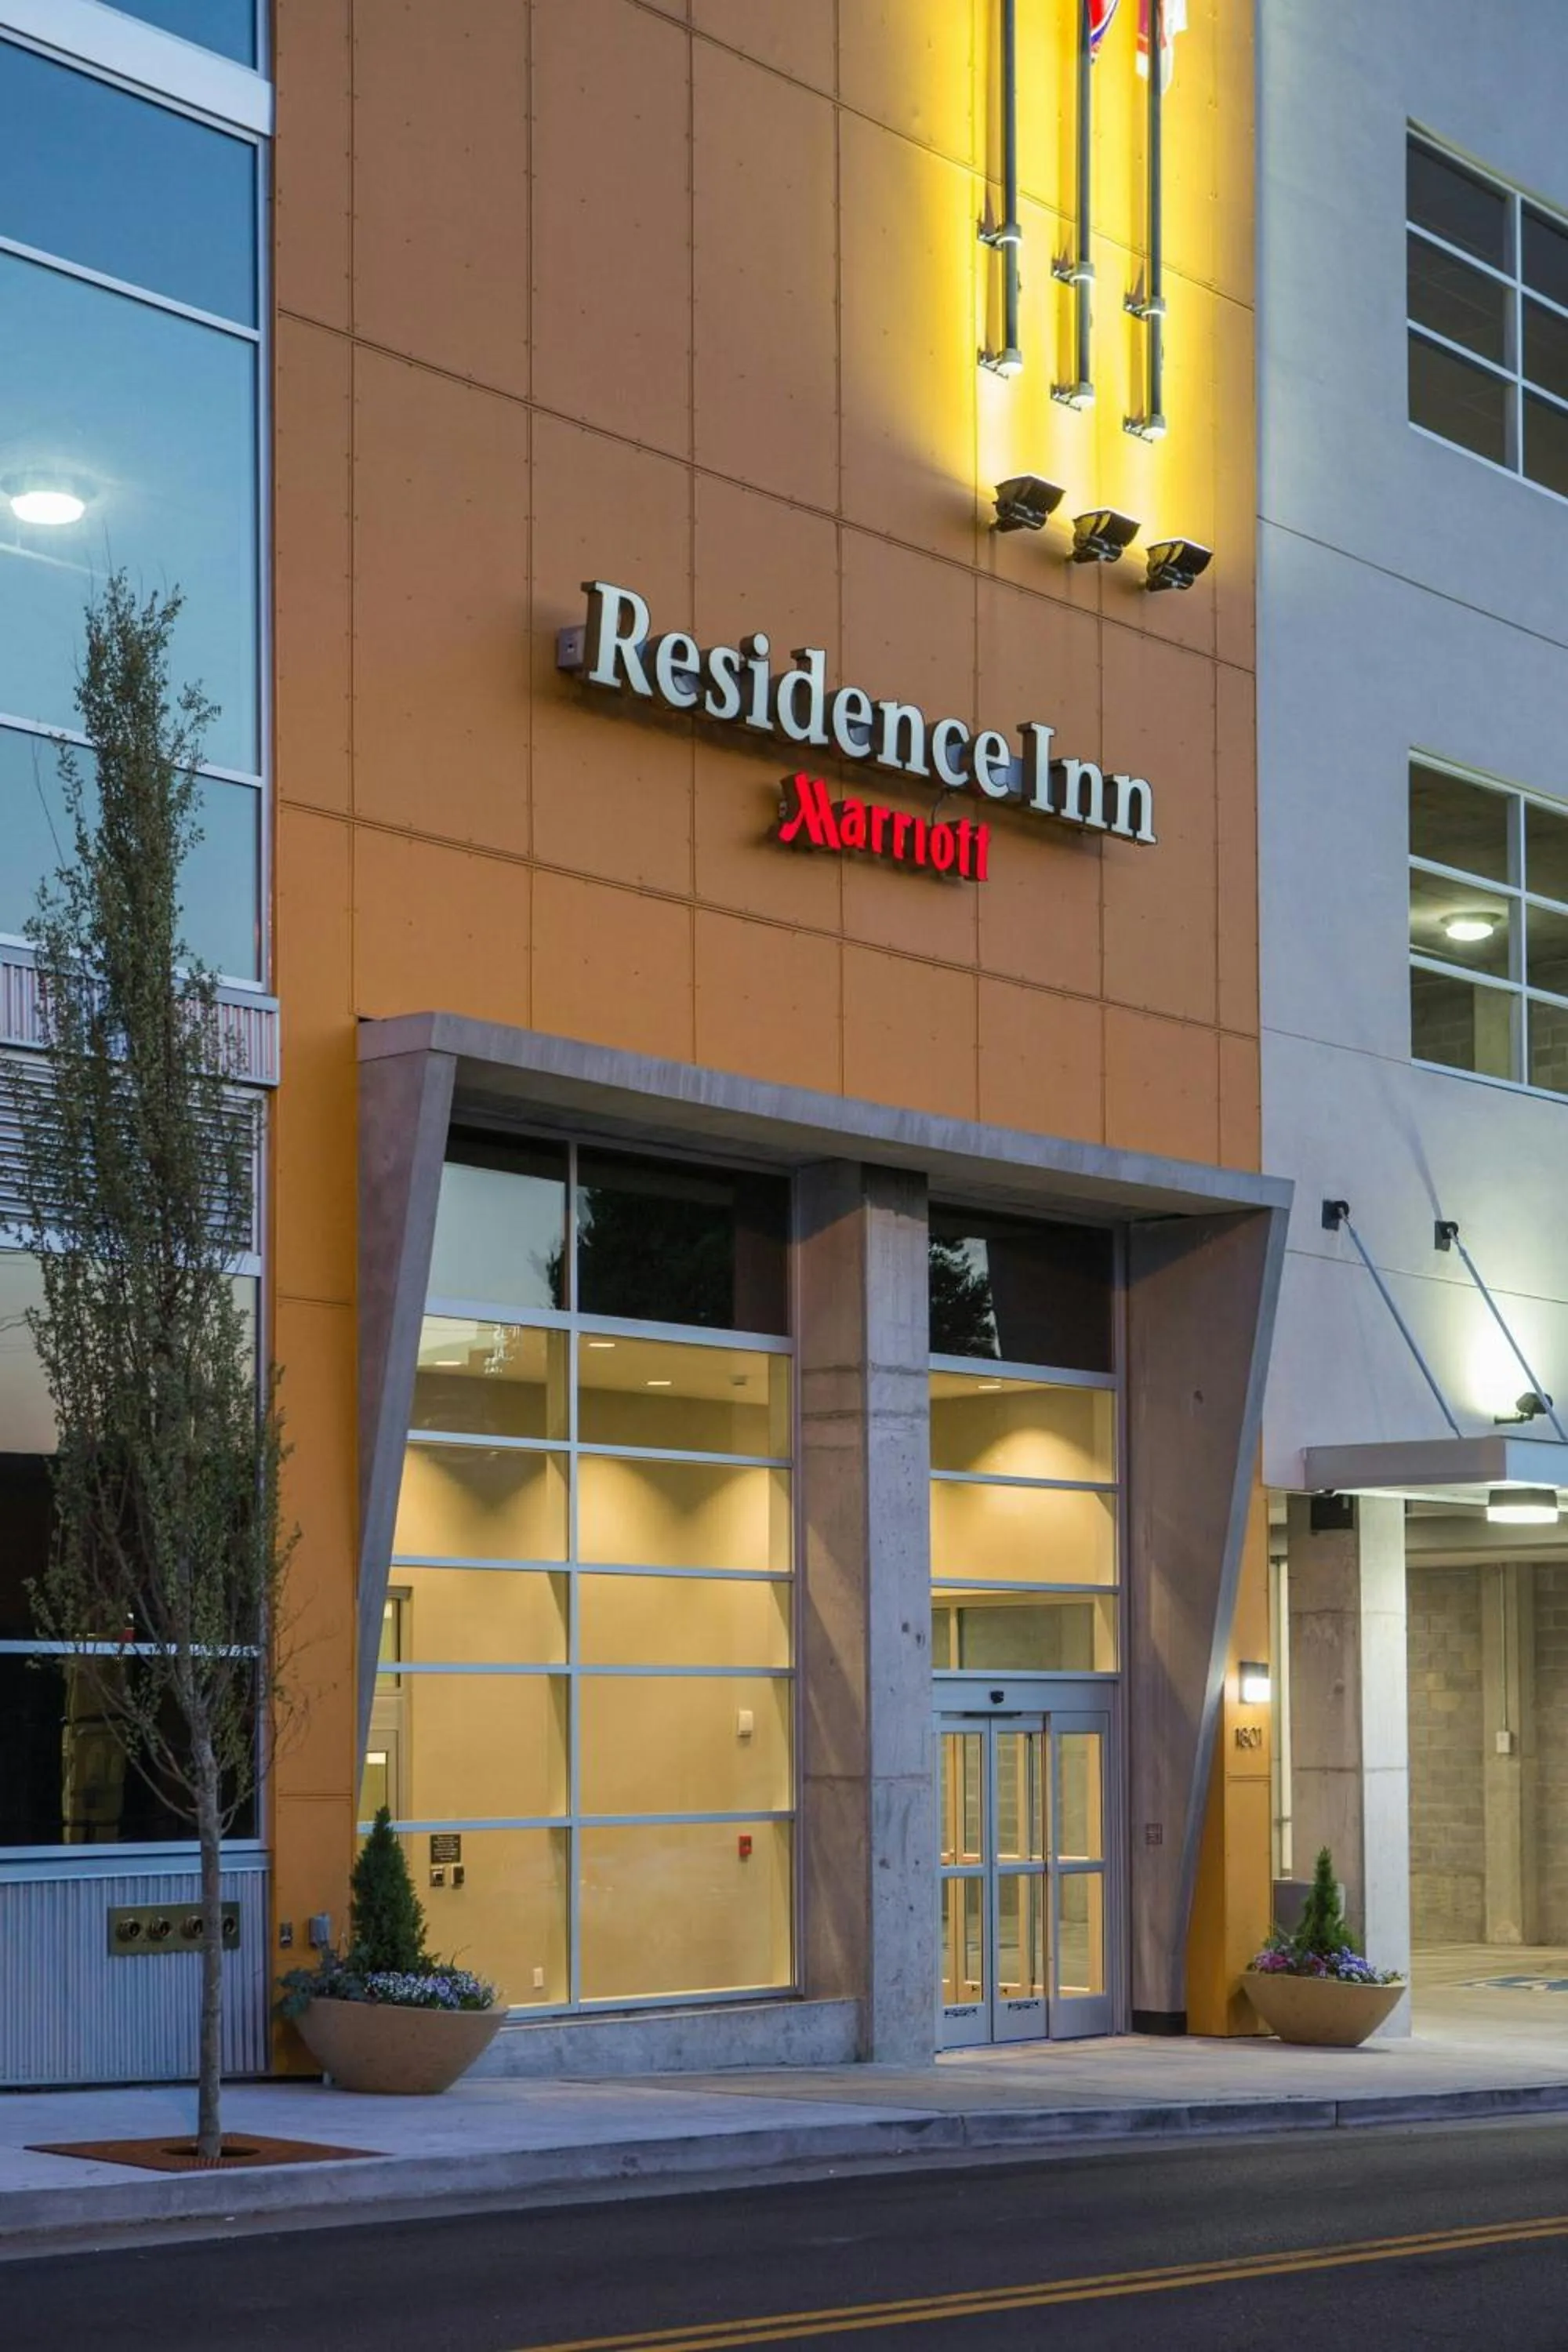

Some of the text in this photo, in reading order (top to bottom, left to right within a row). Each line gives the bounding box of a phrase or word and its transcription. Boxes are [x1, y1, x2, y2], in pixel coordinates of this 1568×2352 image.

[587, 581, 1157, 844] Residence Inn
[778, 771, 990, 882] Marriott
